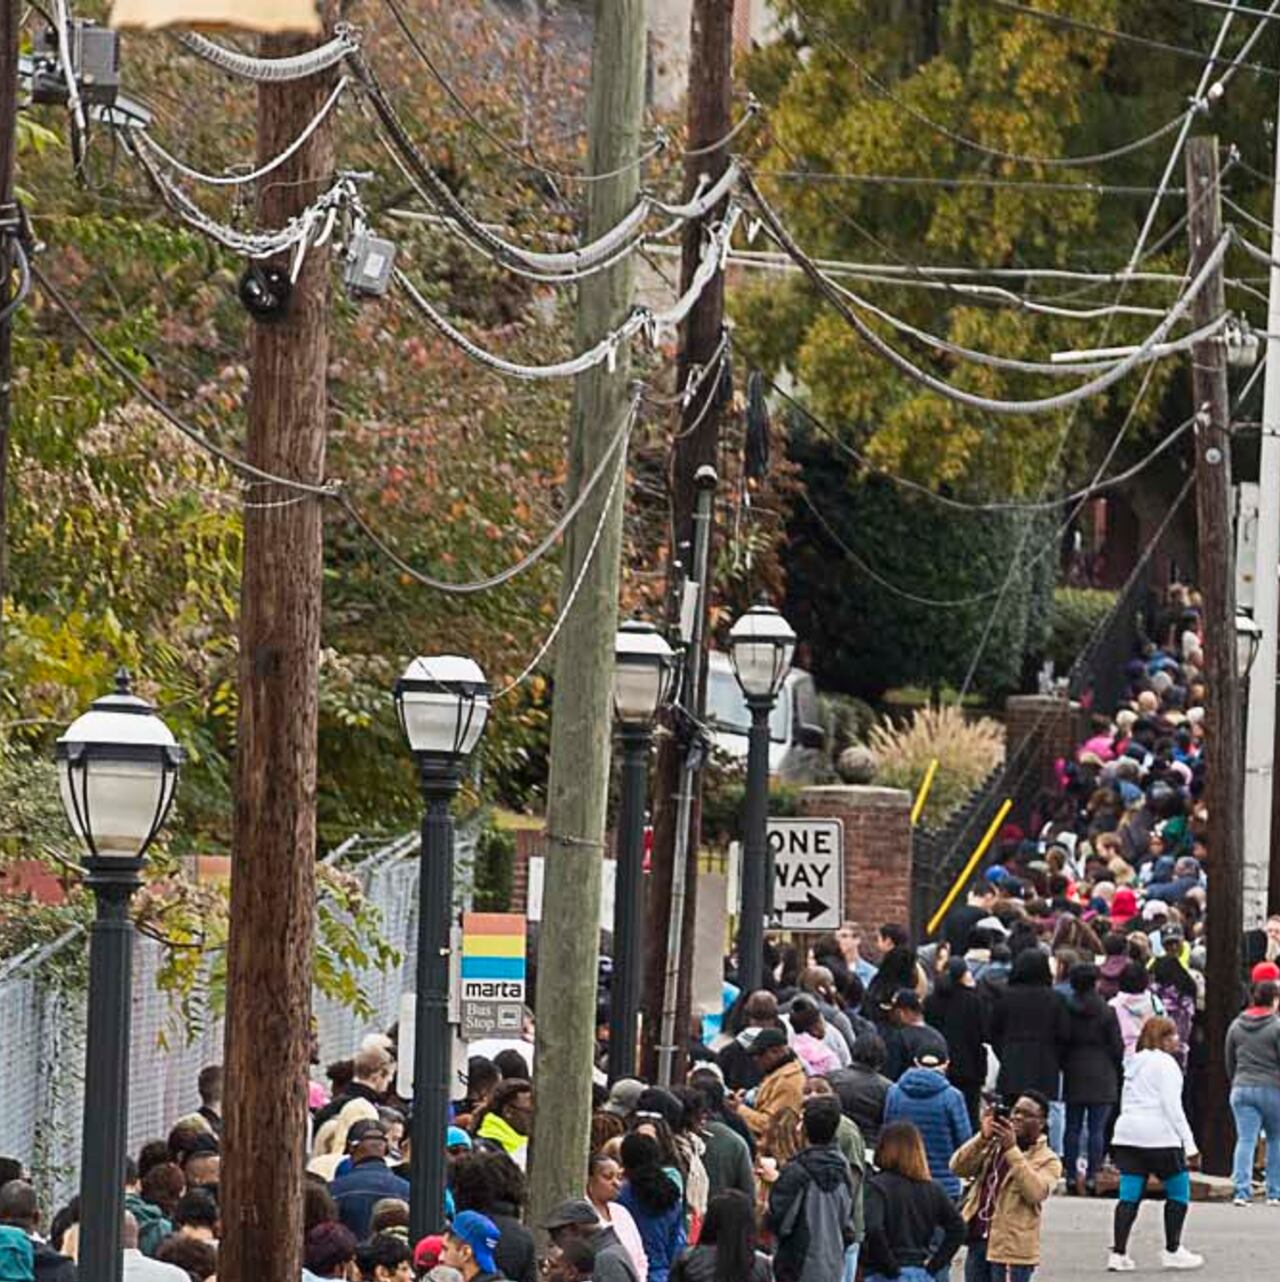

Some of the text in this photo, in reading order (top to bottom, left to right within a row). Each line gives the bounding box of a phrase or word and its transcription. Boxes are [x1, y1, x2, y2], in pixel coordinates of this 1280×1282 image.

[766, 830, 831, 854] ONE
[466, 982, 522, 998] marta
[466, 1002, 492, 1017] Bus
[466, 1016, 495, 1032] Stop
